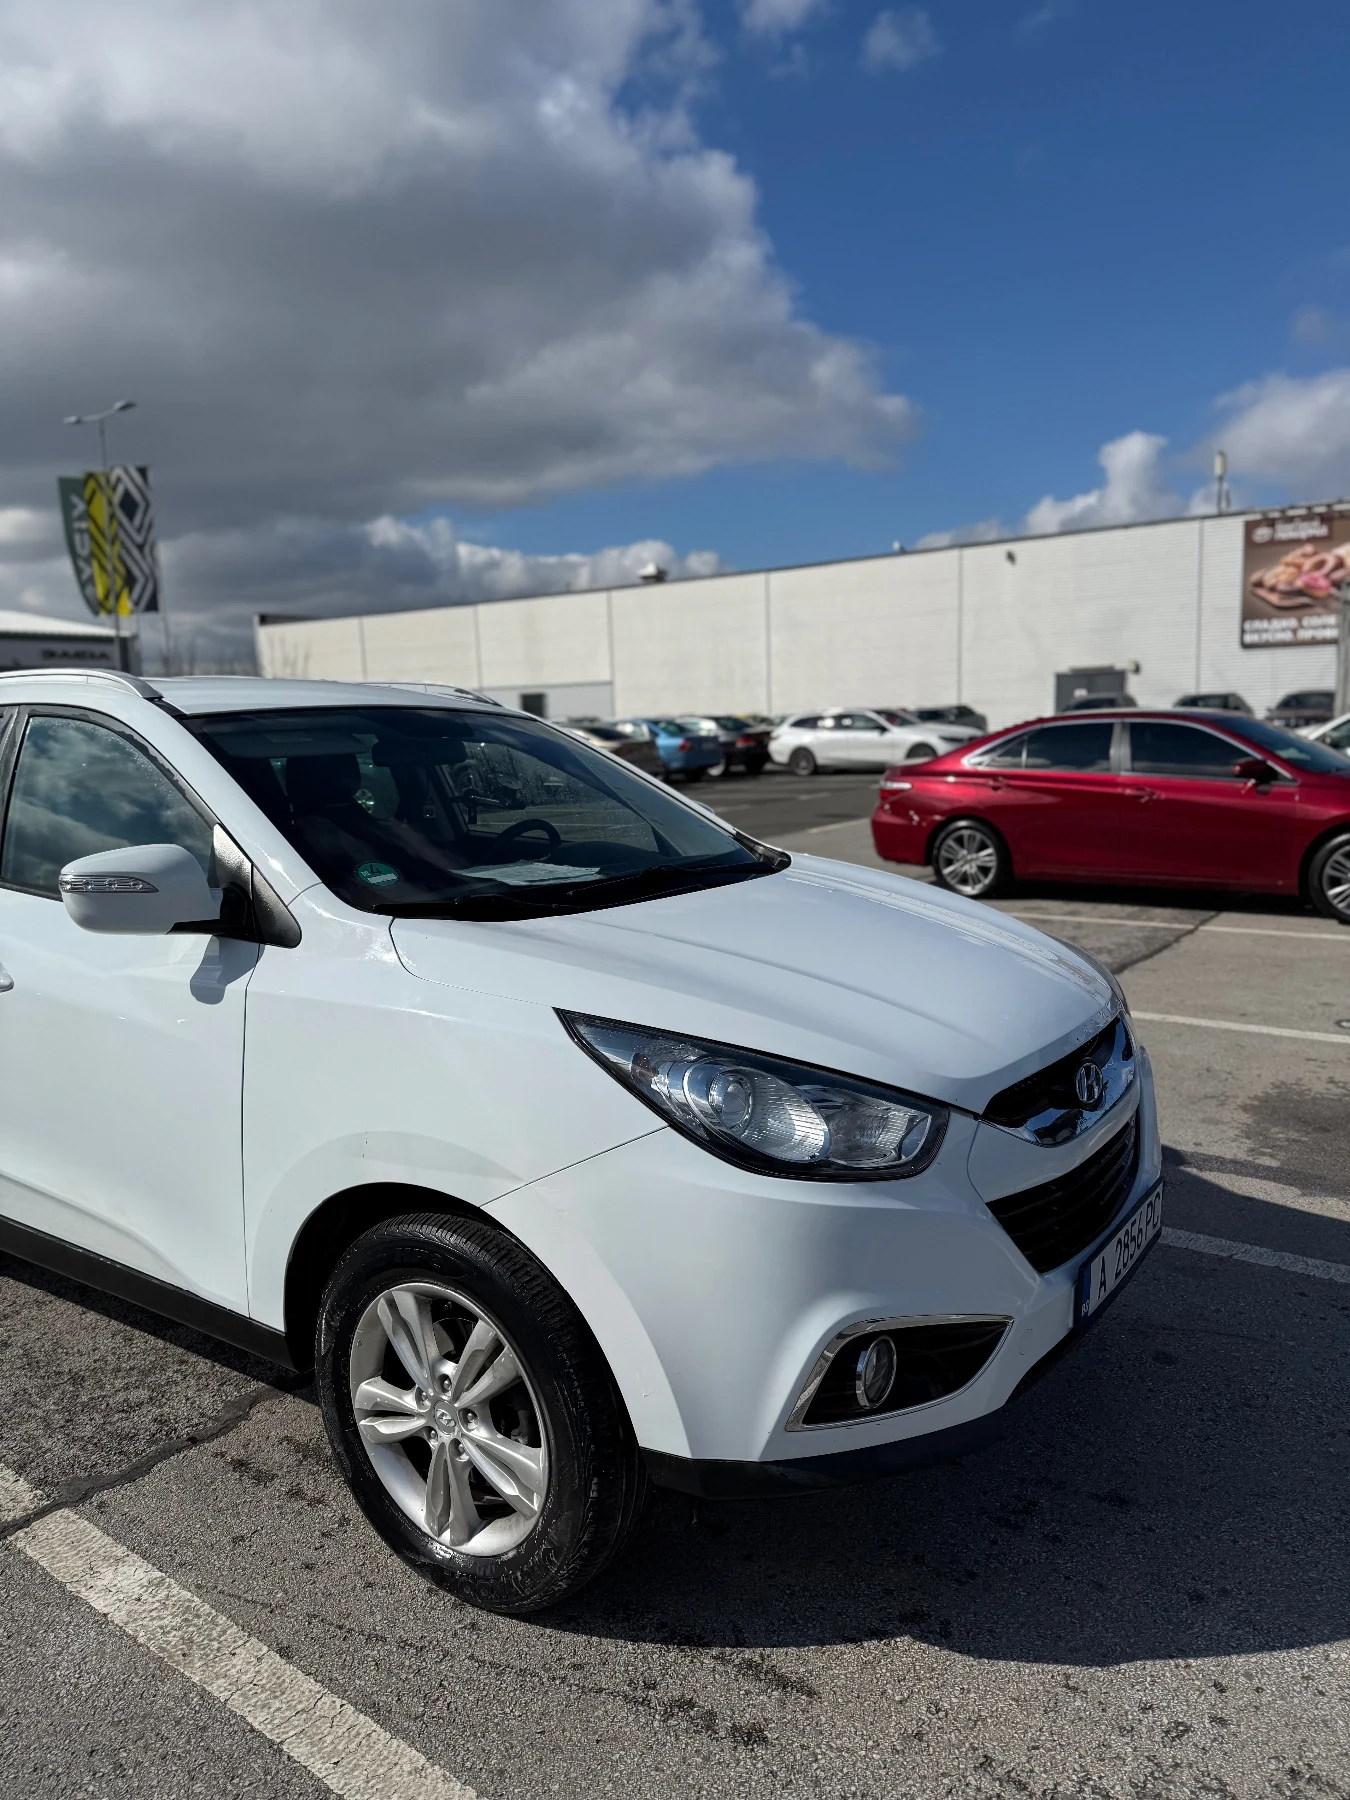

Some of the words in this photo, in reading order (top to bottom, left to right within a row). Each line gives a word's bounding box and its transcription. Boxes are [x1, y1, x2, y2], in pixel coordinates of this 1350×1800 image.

[1097, 1255, 1107, 1300] A
[1114, 1209, 1143, 1281] 2856
[1144, 1191, 1161, 1241] PC
